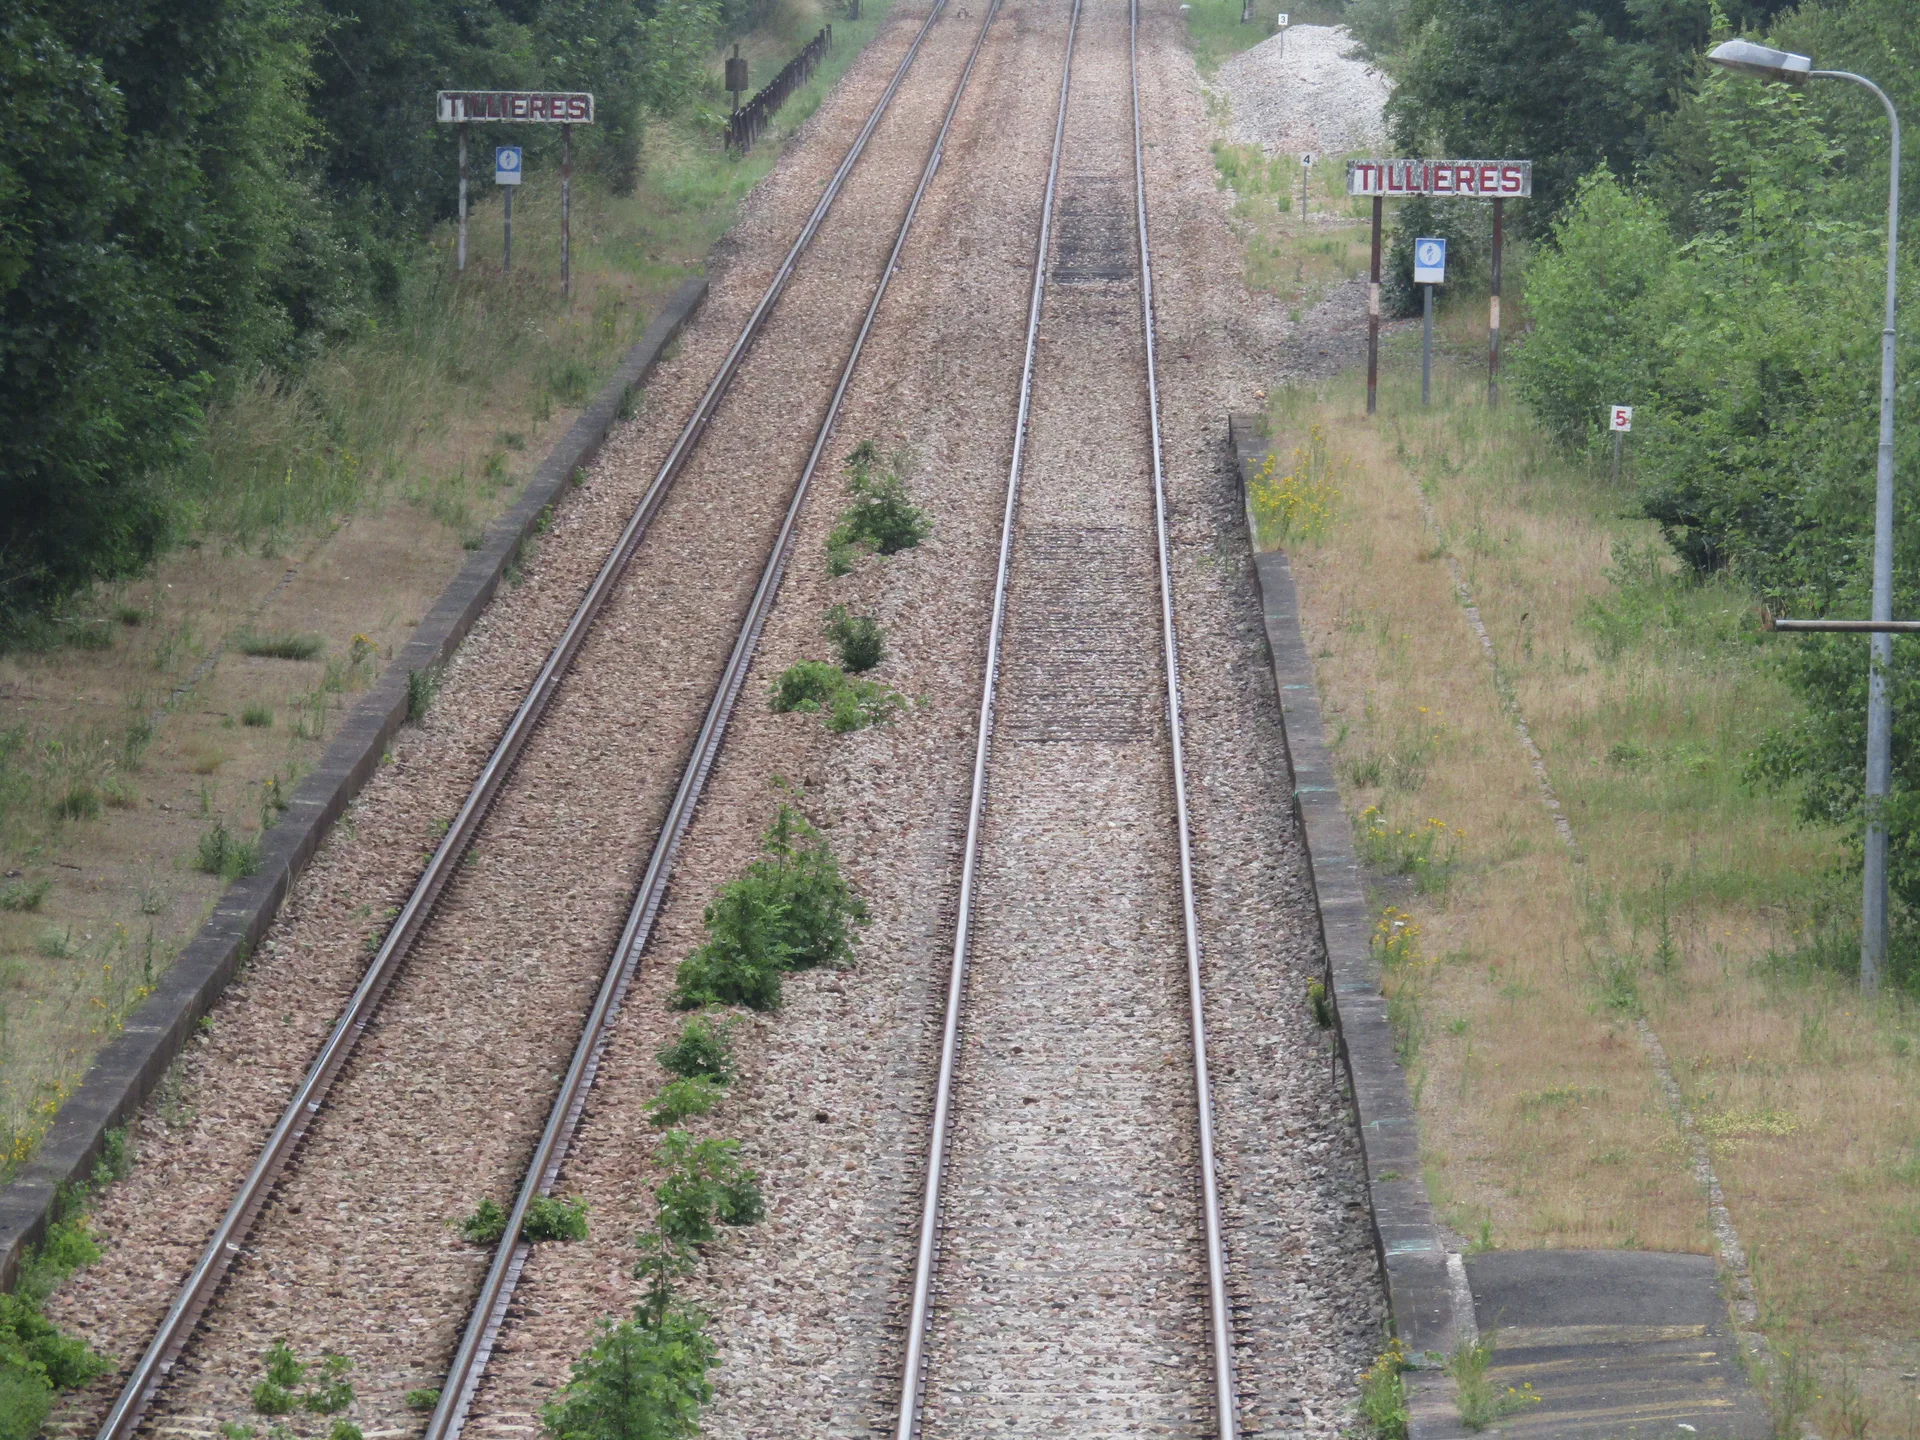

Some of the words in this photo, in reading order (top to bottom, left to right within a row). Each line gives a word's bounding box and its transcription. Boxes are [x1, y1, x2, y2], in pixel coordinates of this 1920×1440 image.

[445, 95, 586, 119] TILLIERES
[1303, 154, 1311, 164] 4
[1356, 164, 1521, 192] TILLIERES
[1615, 410, 1627, 427] 5
